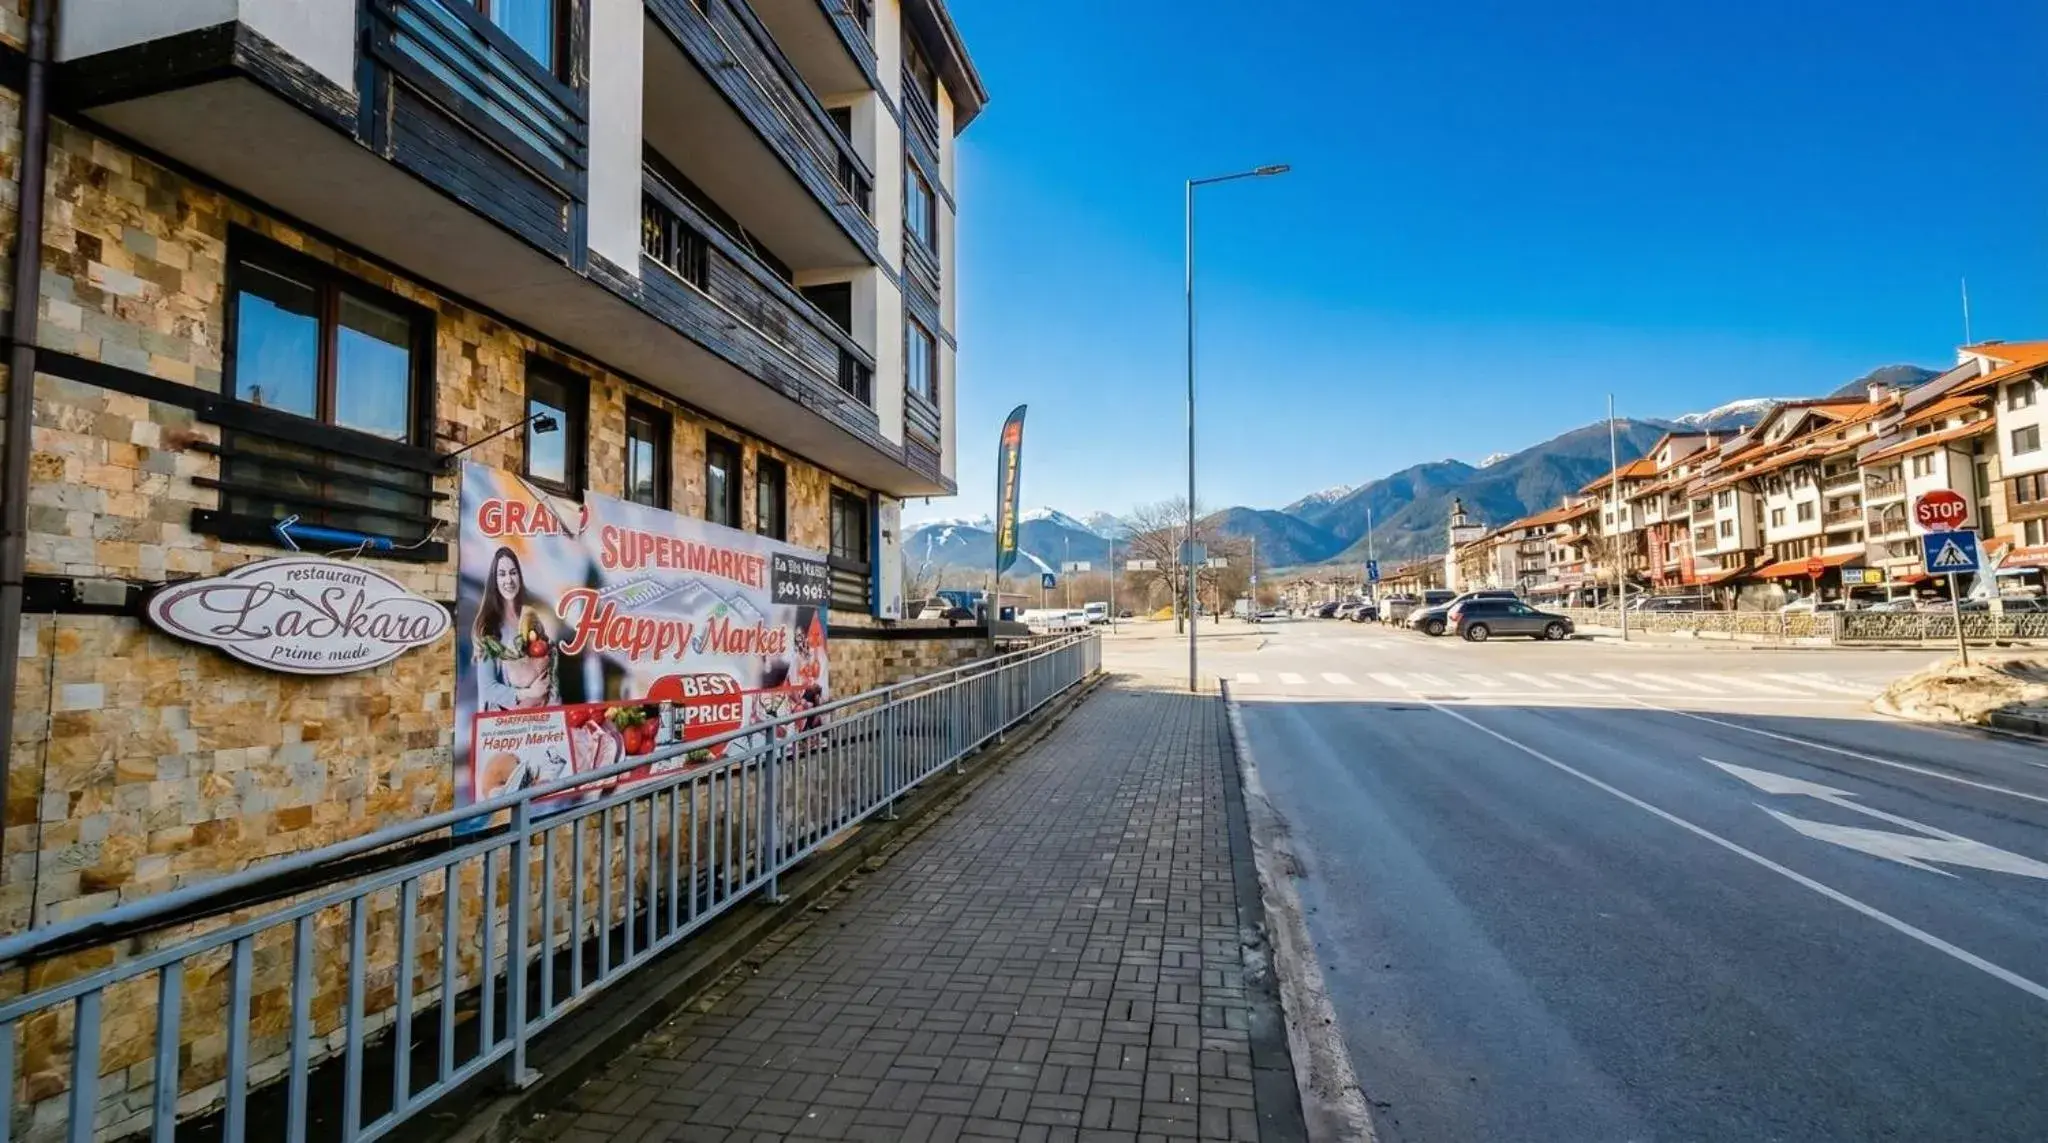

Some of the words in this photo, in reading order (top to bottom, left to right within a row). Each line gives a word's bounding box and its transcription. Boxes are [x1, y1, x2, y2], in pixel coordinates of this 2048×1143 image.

[477, 497, 589, 538] GRA
[1920, 501, 1964, 520] STOP
[600, 524, 766, 592] SUPERMARKET
[287, 566, 367, 586] restaurant
[556, 587, 693, 663] Happy
[697, 614, 787, 656] Market
[270, 645, 321, 661] prime
[328, 645, 370, 659] made
[681, 675, 736, 697] BEST
[685, 702, 742, 725] PRICE
[482, 736, 523, 752] Happy
[525, 731, 564, 746] Market
